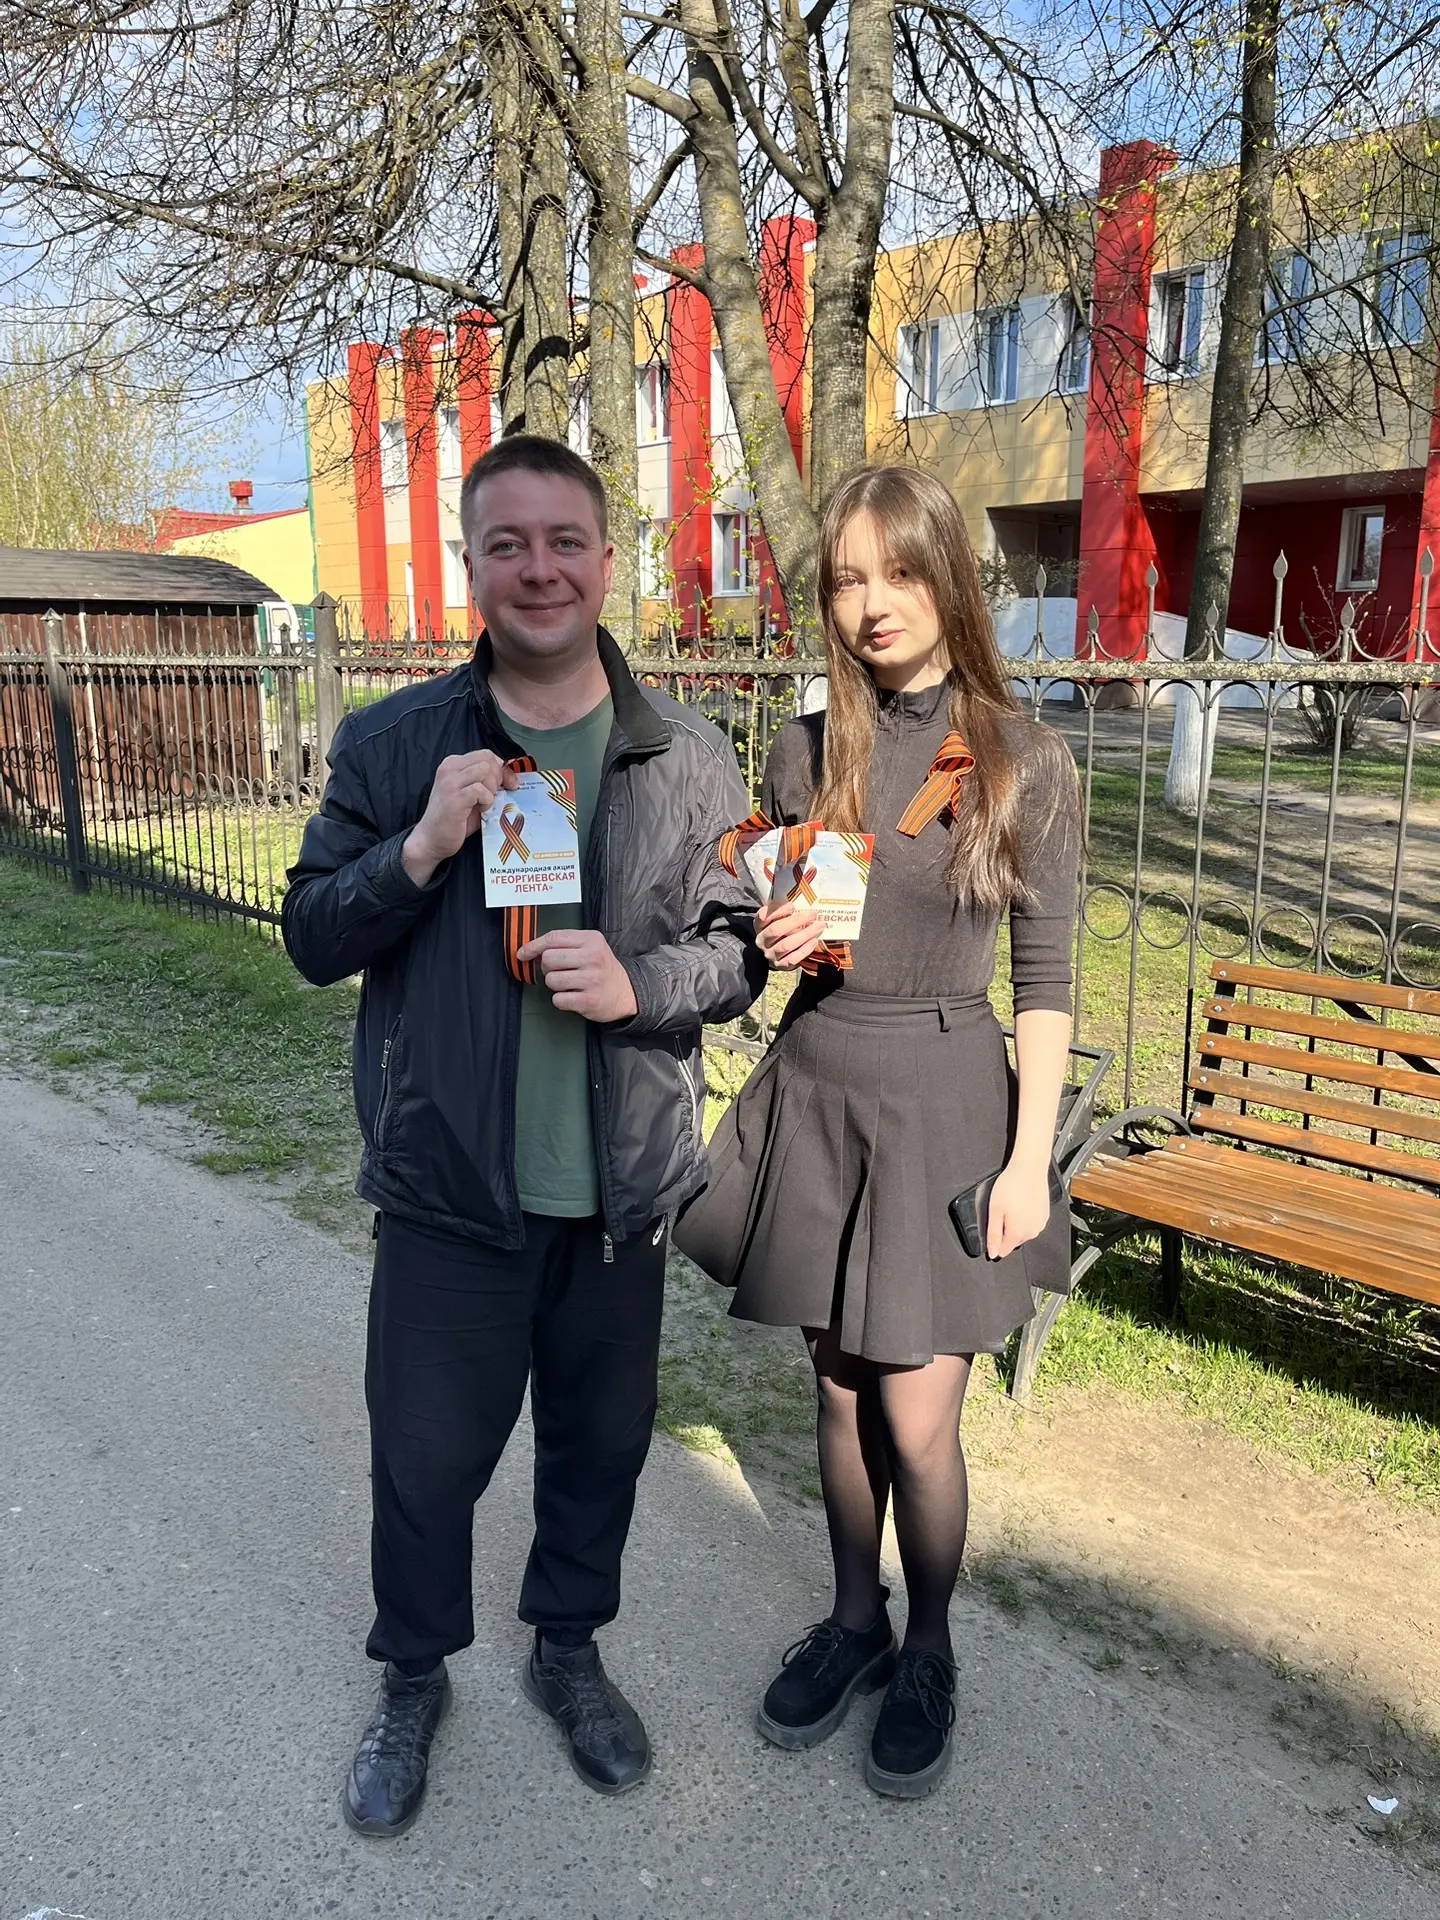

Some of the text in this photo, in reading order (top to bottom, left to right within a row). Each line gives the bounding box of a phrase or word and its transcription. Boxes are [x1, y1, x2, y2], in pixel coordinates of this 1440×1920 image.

[490, 866, 552, 874] Международная
[491, 872, 575, 884] «ГЕОРГИЕВСКАЯ
[515, 883, 553, 893] ЛЕНТА»
[815, 914, 857, 922] ЕВСКАЯ
